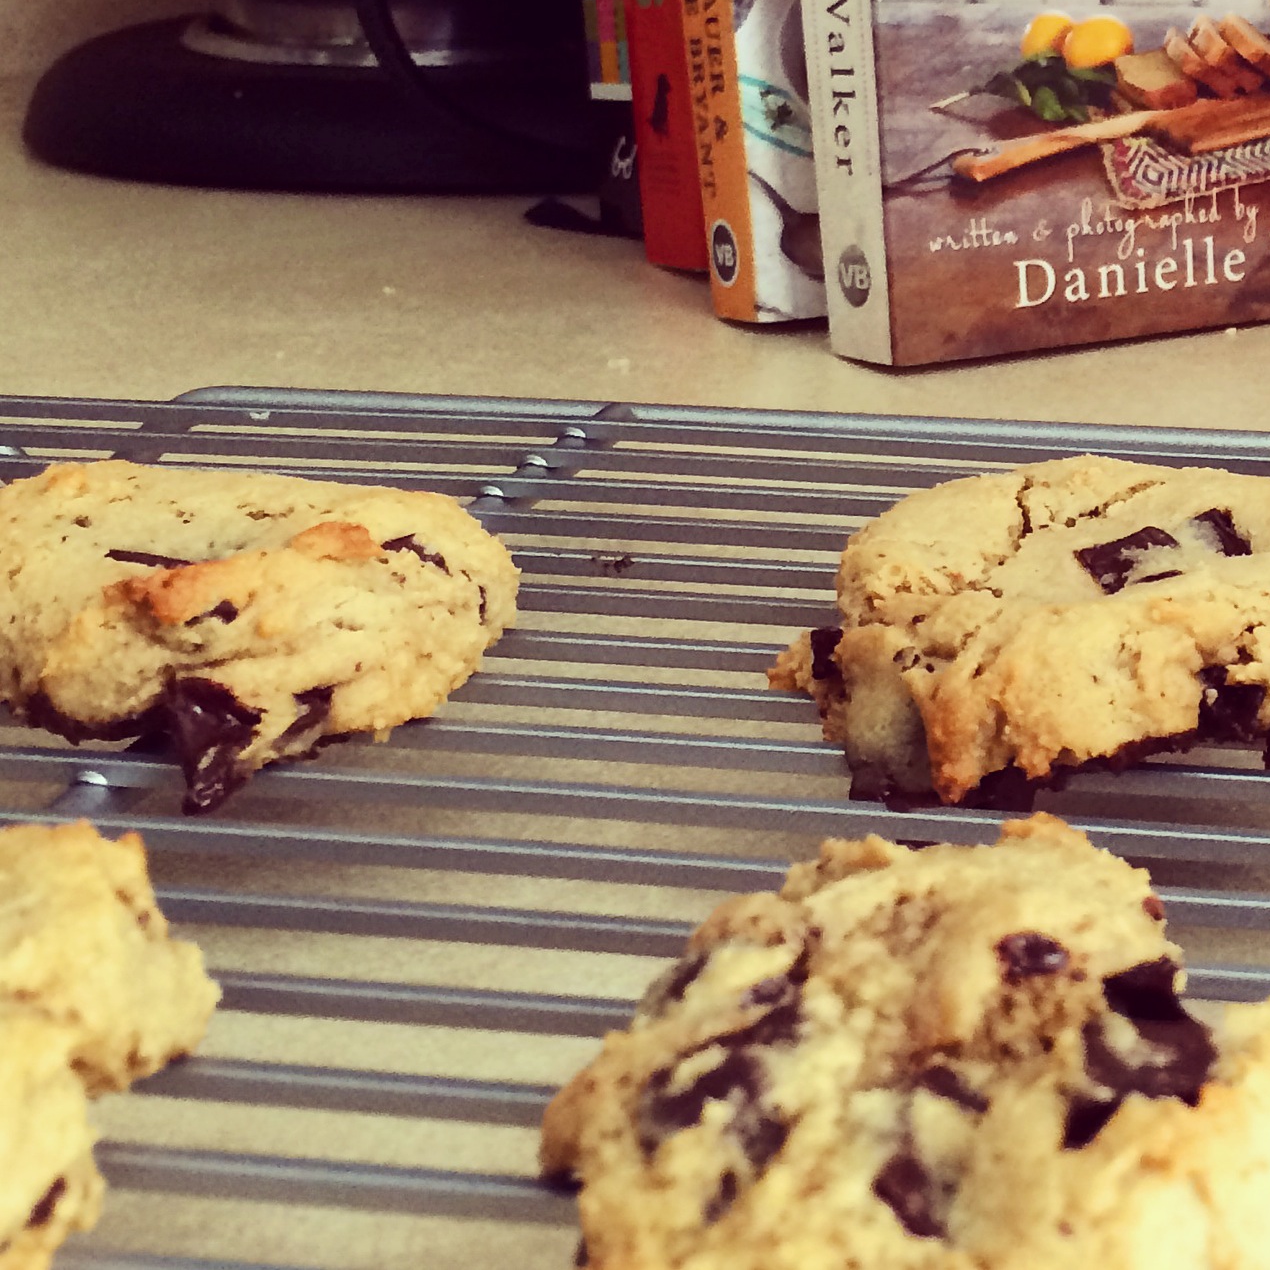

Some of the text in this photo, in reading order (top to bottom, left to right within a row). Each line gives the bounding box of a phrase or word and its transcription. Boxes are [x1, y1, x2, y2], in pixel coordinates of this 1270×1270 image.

[690, 37, 717, 198] BRYANT
[714, 115, 729, 142] &
[929, 217, 1018, 253] written
[1067, 187, 1222, 261] photographed
[1235, 183, 1259, 244] by
[714, 247, 737, 271] VB
[839, 262, 871, 292] VB
[1011, 236, 1246, 309] Danielle
